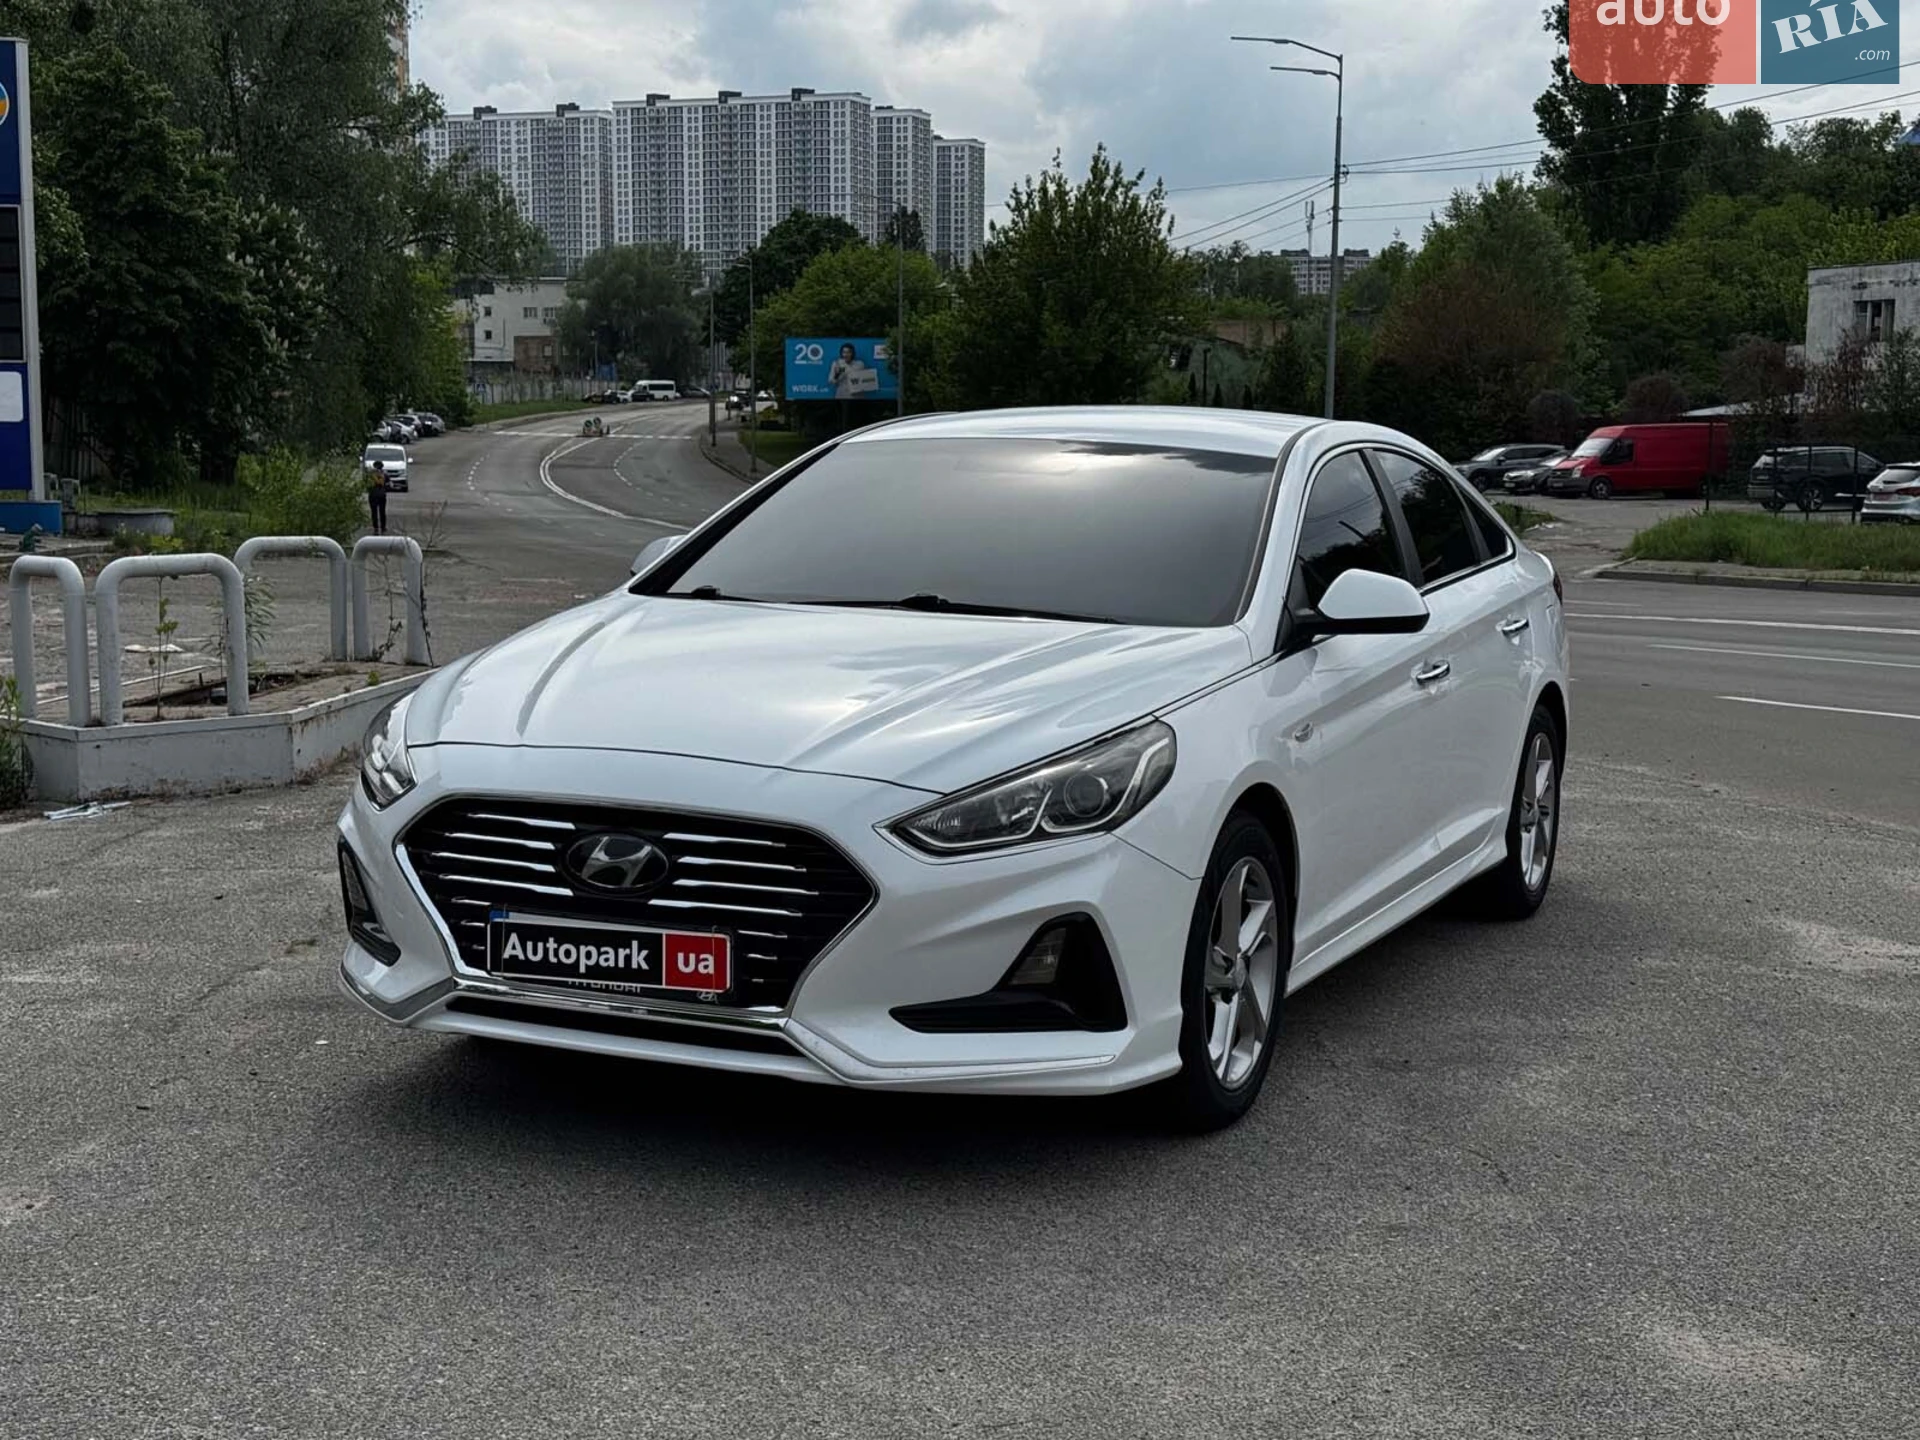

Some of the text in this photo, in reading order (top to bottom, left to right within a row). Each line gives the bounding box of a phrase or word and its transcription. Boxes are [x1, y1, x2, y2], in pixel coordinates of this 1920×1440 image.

[794, 343, 824, 364] 20
[502, 932, 650, 974] Autopark
[677, 951, 715, 975] ua
